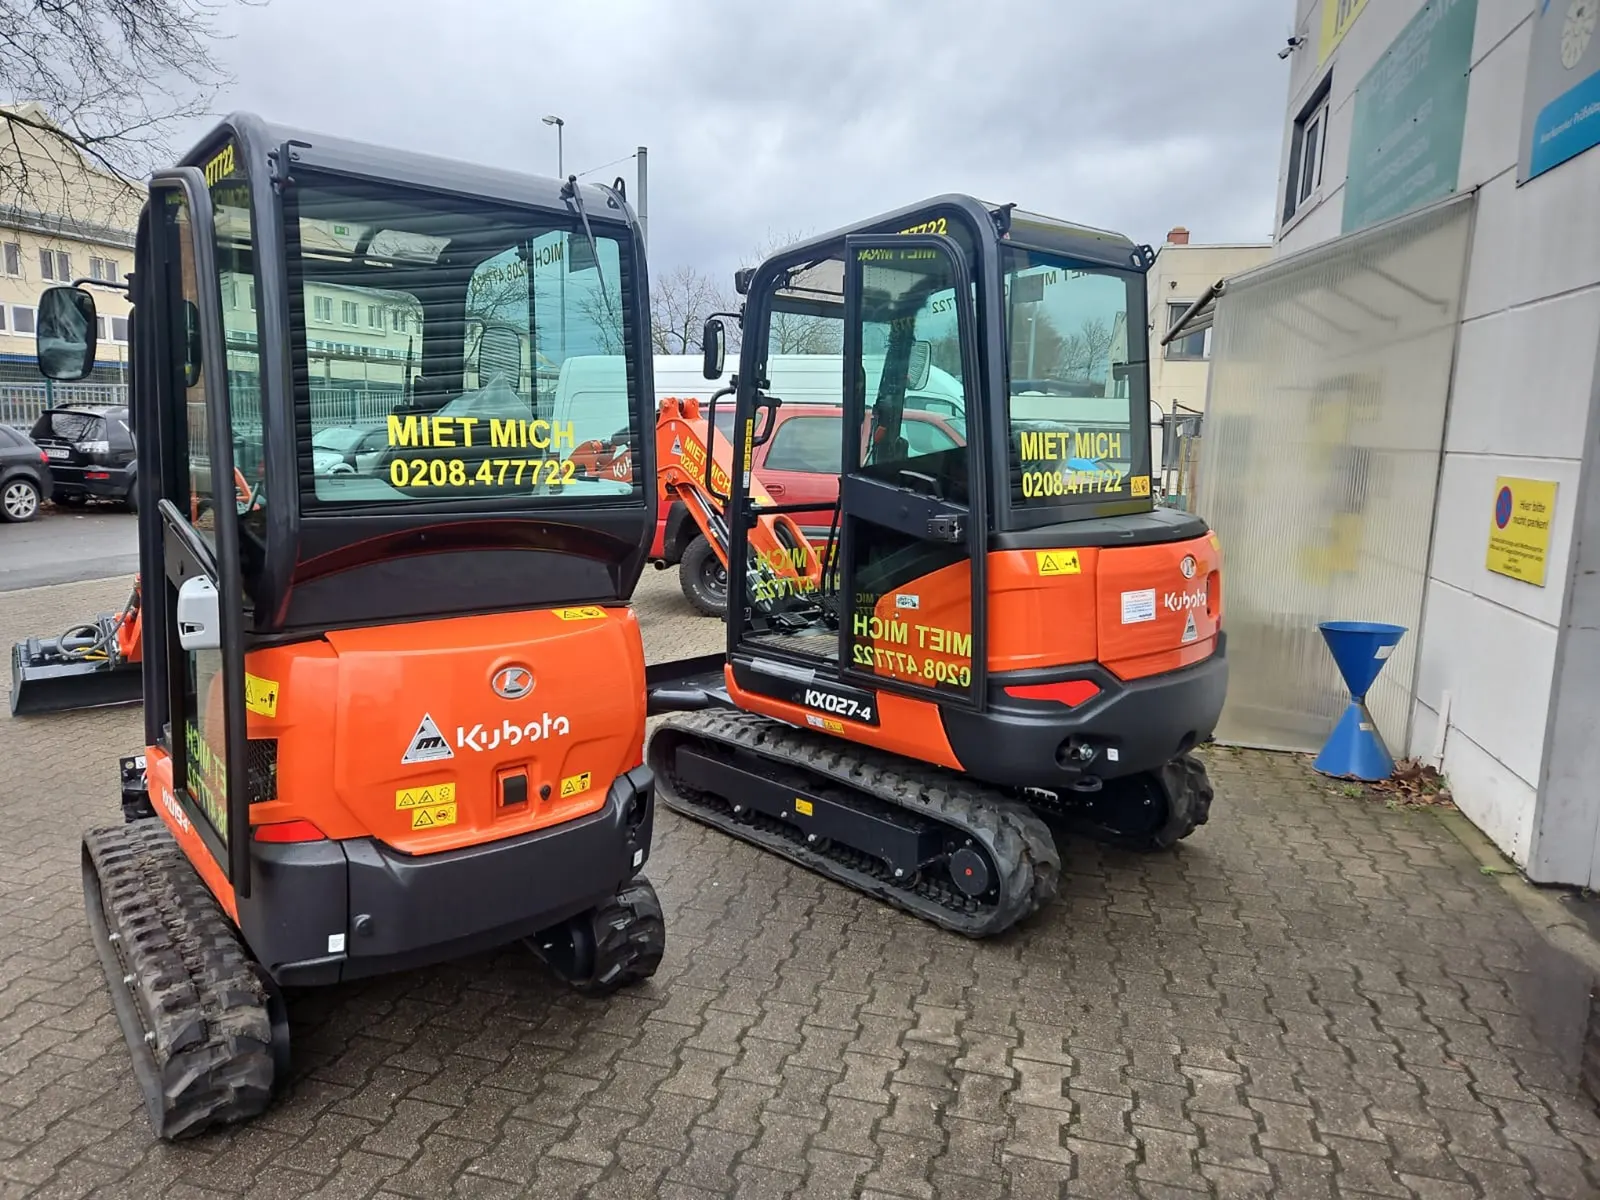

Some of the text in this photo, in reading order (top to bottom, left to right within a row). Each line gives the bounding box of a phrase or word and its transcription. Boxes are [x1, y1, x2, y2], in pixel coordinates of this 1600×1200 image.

[387, 415, 576, 449] MIET MICH
[1021, 431, 1120, 460] MIET MICH
[684, 436, 707, 466] MIET
[390, 458, 577, 487] 0208.477722
[1022, 469, 1122, 498] 0208.477722
[1164, 588, 1207, 612] Kubota
[805, 688, 872, 721] KX027-4
[457, 712, 569, 752] Kubota
